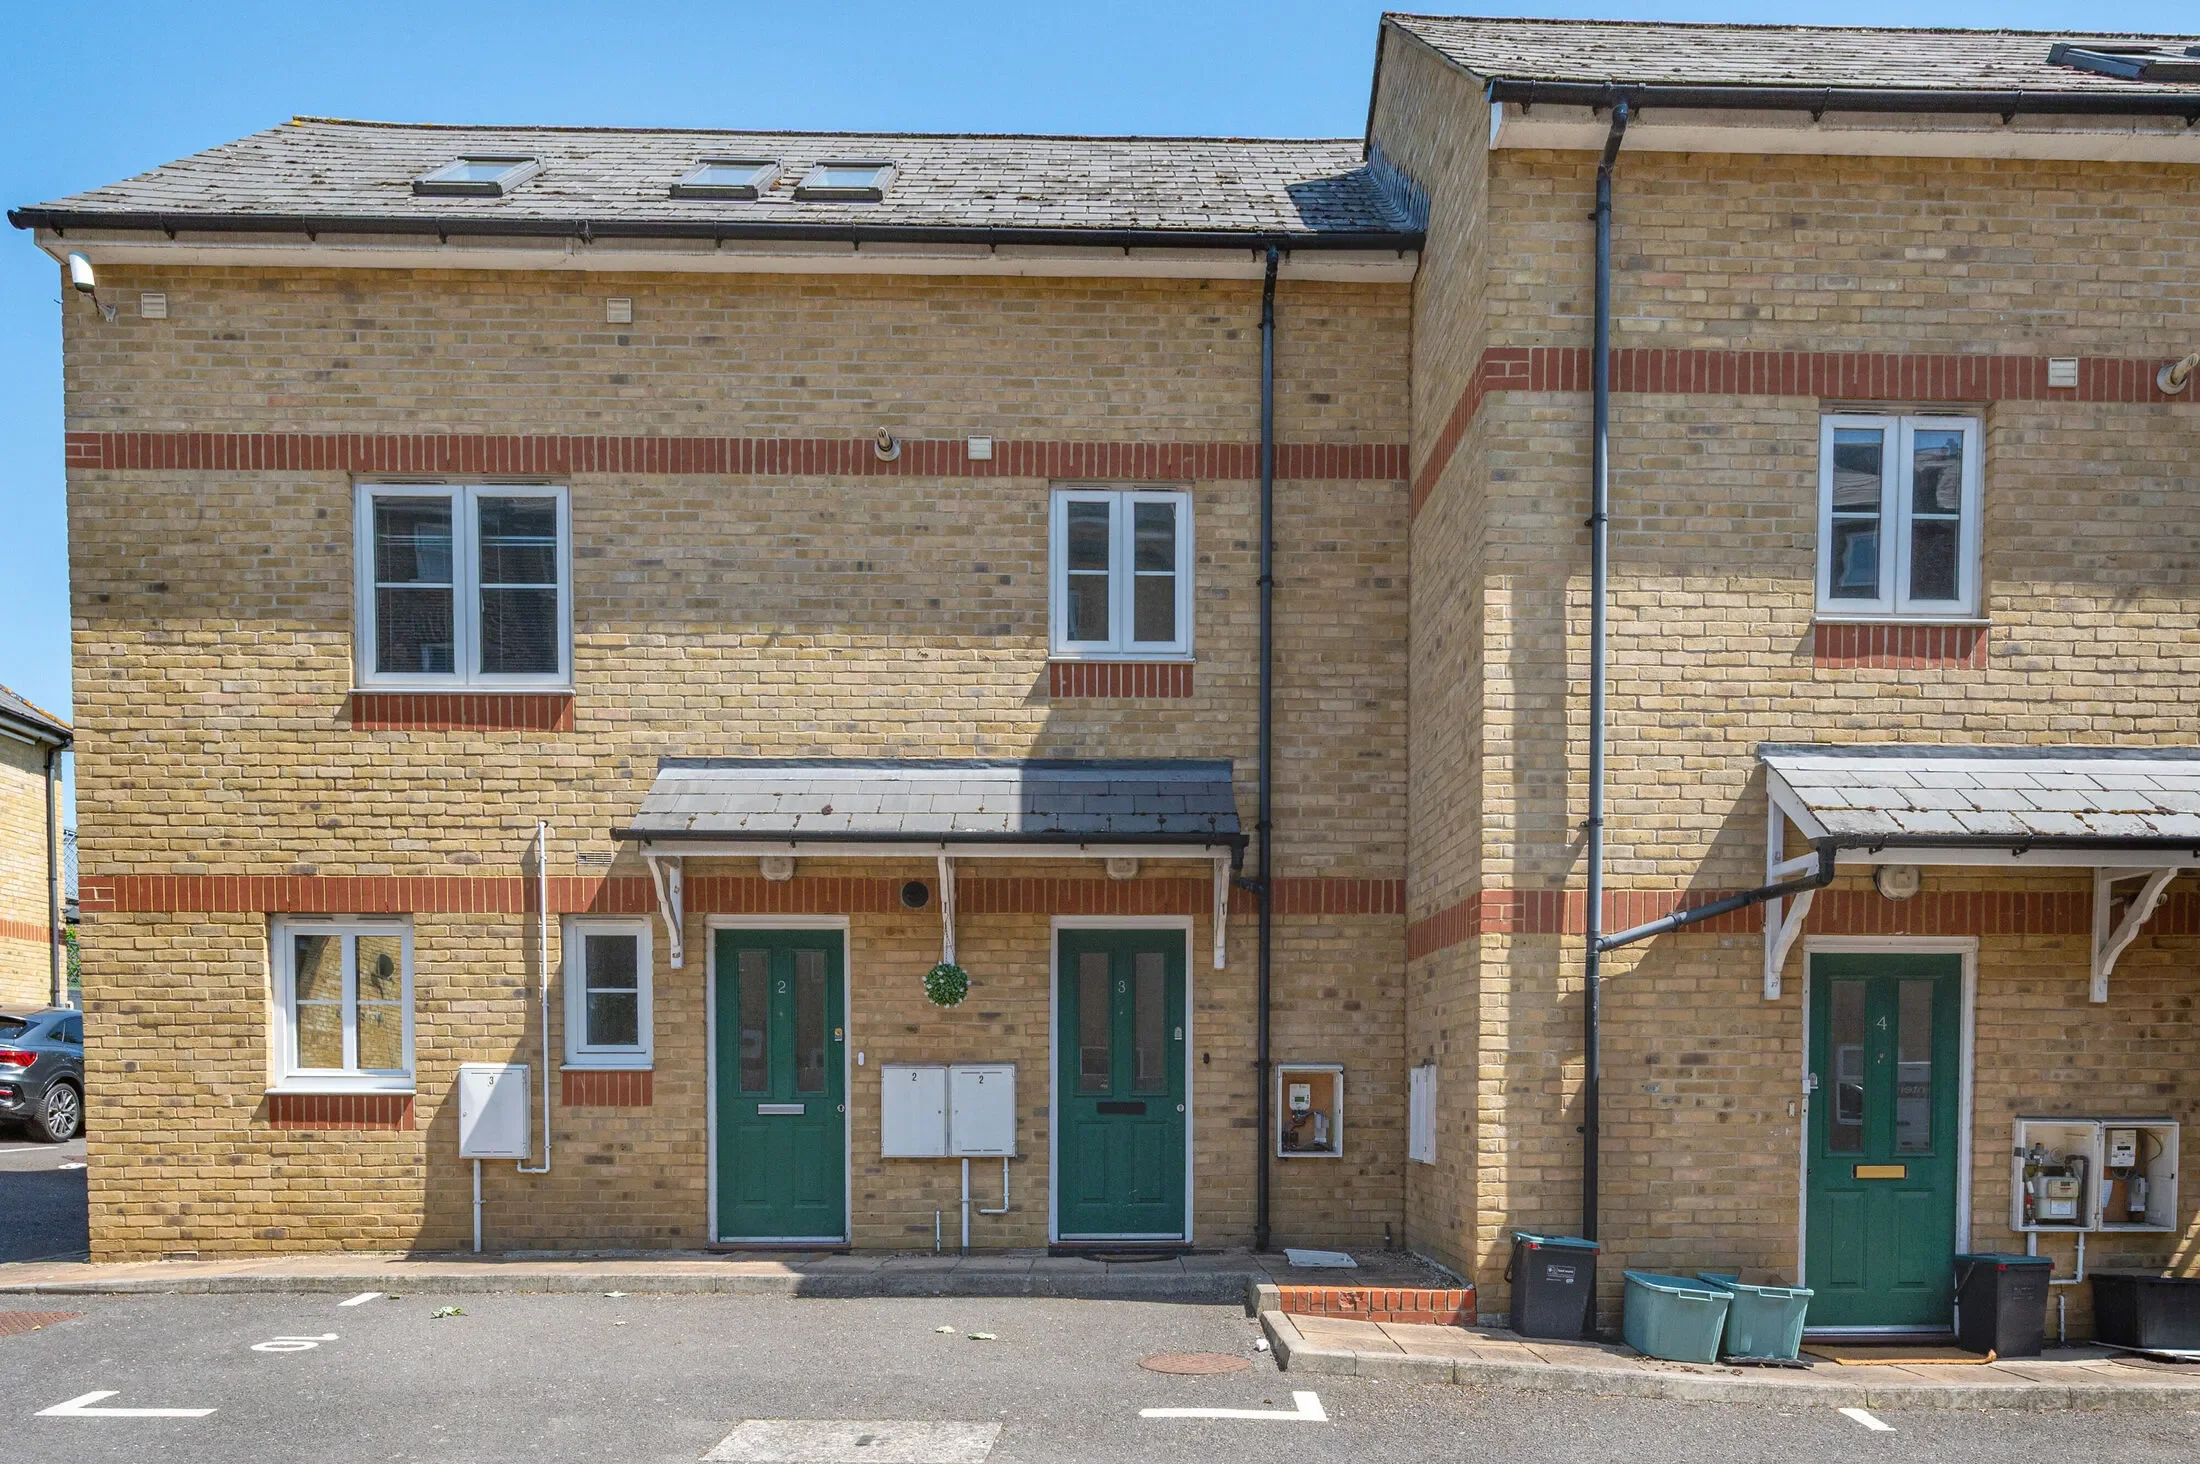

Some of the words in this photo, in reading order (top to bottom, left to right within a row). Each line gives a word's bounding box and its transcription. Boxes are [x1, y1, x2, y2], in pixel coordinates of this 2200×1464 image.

[777, 980, 786, 994] 2
[1118, 980, 1126, 993] 3
[1876, 1015, 1888, 1030] 4
[488, 1075, 494, 1085] 3
[911, 1072, 917, 1081] 2
[978, 1075, 984, 1084] 2
[250, 1333, 340, 1352] 10
